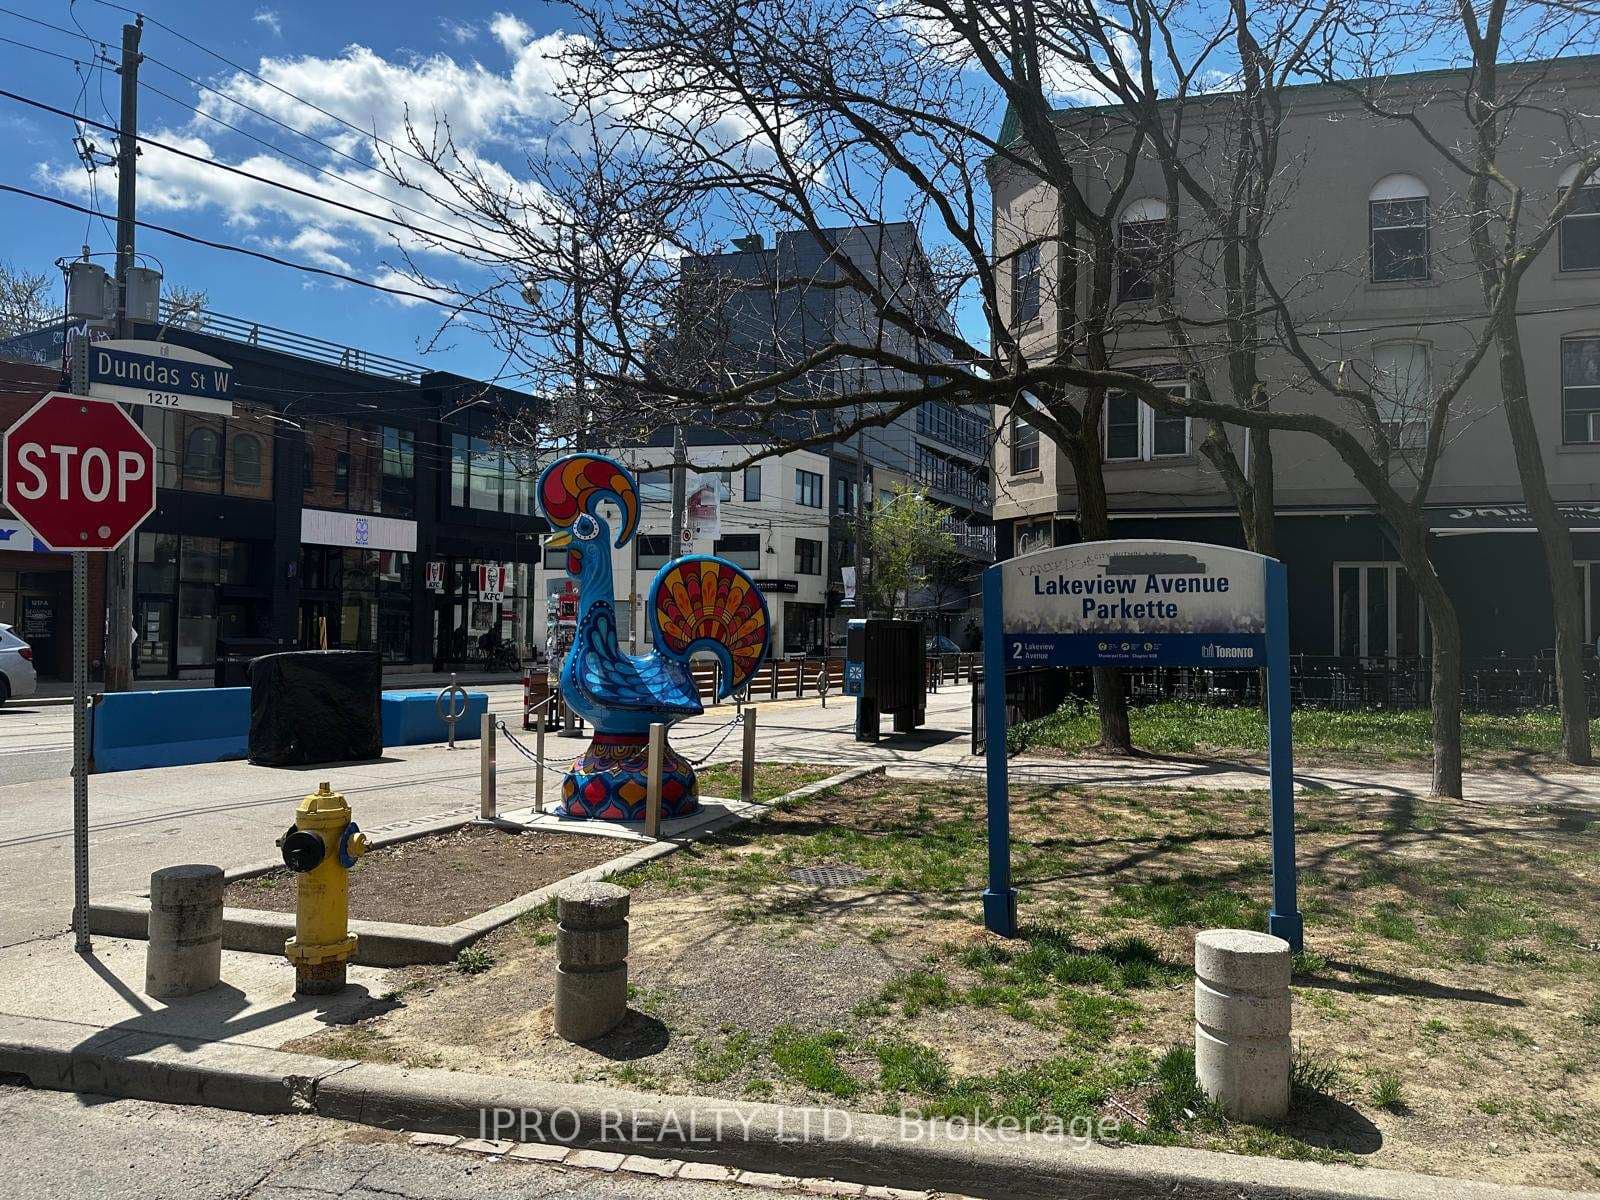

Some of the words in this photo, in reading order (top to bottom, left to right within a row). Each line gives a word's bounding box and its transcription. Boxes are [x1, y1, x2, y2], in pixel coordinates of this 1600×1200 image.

[97, 351, 181, 387] Dundas
[190, 370, 206, 390] St
[213, 372, 230, 394] W
[147, 392, 180, 407] 1212
[15, 442, 146, 503] STOP
[1034, 574, 1137, 595] Lakeview
[1144, 574, 1230, 594] Avenue
[483, 592, 501, 601] KFC
[1082, 598, 1178, 619] Parkette
[1012, 642, 1023, 659] 2
[1024, 642, 1055, 651] Lakeview
[1214, 645, 1254, 658] TORONTO
[1024, 652, 1049, 660] Avenue
